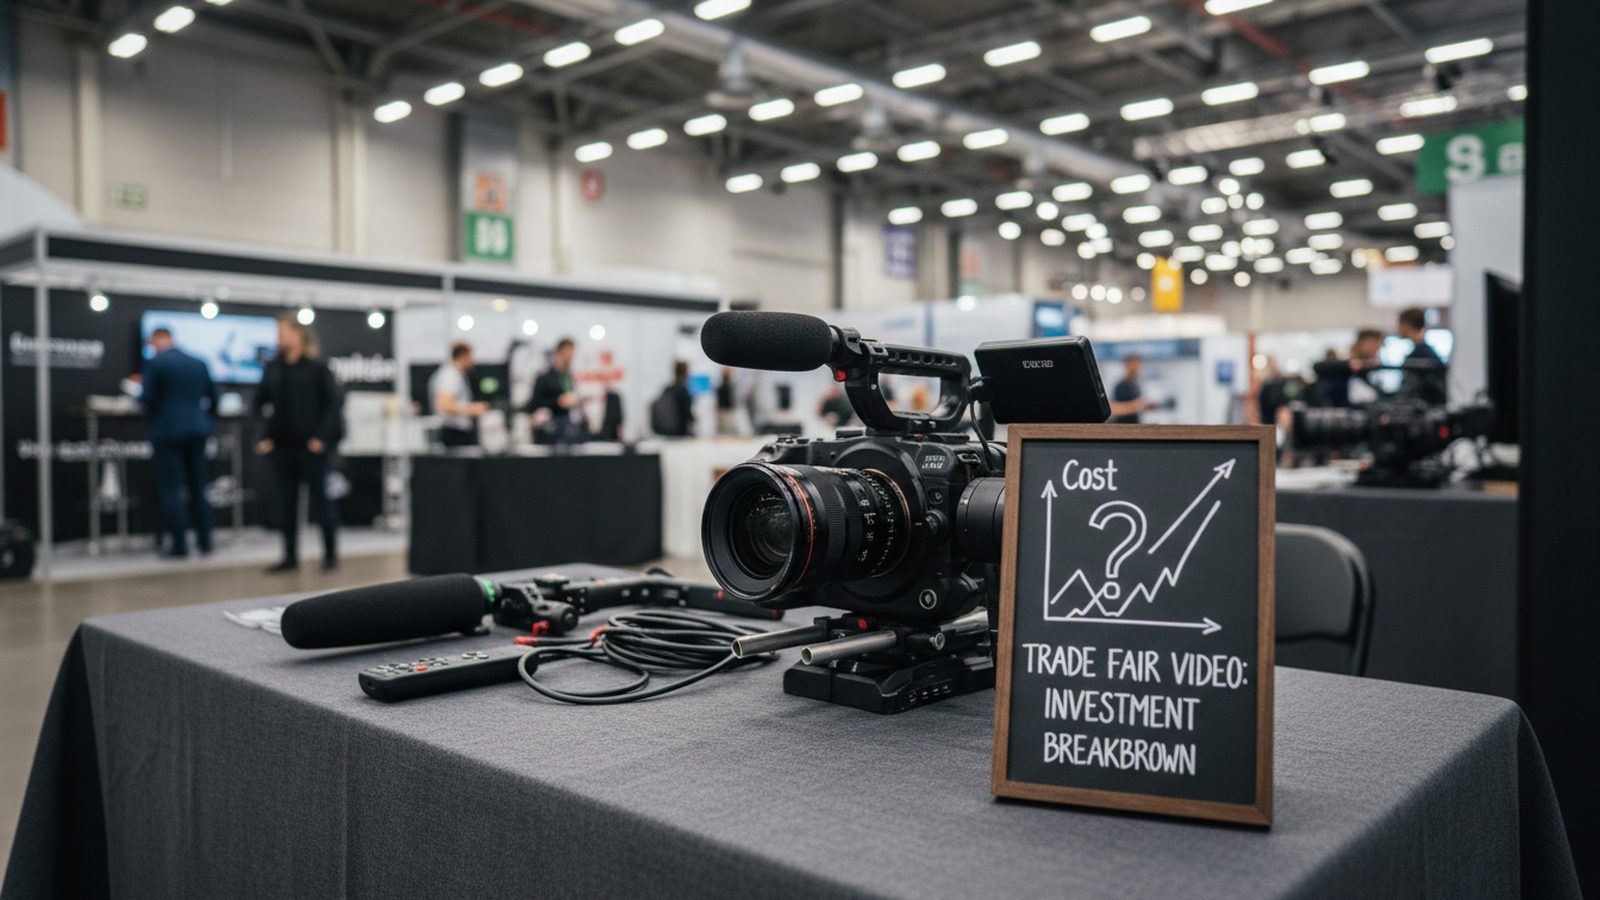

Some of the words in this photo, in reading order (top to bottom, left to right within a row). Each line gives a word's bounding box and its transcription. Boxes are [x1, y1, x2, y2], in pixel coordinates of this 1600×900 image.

[1062, 459, 1118, 491] Cost
[1022, 643, 1097, 678] TRADE
[1107, 648, 1161, 683] FAIR
[1171, 652, 1248, 690] VIDEO:
[1044, 688, 1201, 731] INVESTMENT
[1043, 732, 1196, 776] BREAKBROWN
